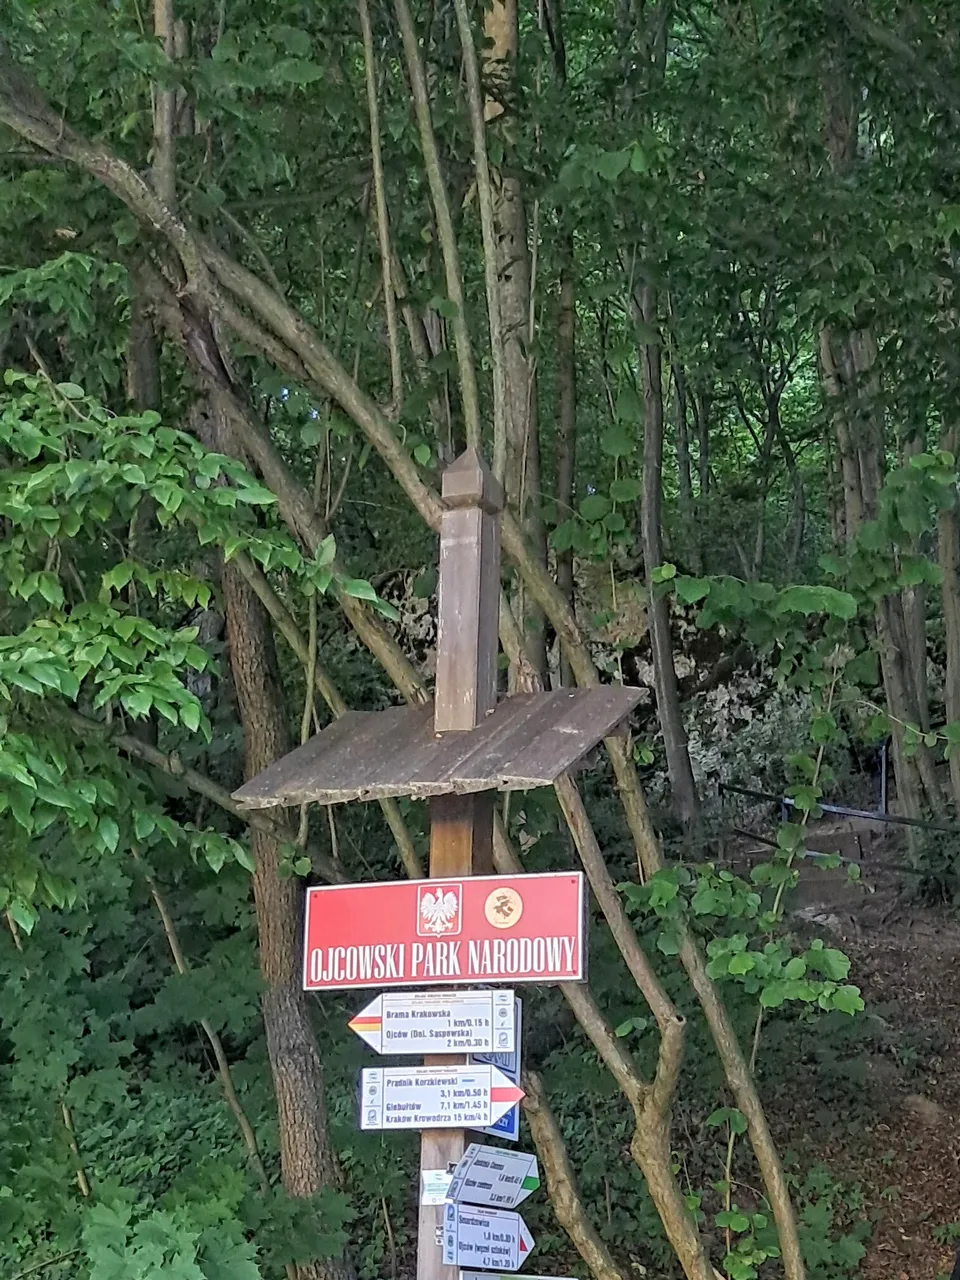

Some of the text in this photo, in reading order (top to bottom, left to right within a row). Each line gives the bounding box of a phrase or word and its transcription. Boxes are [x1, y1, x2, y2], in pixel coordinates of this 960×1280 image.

[311, 936, 576, 982] OJCOWSKI PARK NARODOWY
[386, 1010, 451, 1019] Brama Krakowska
[386, 1030, 408, 1039] Ojców
[447, 1039, 452, 1047] 2
[483, 1089, 488, 1097] h
[386, 1115, 412, 1123] Kraków
